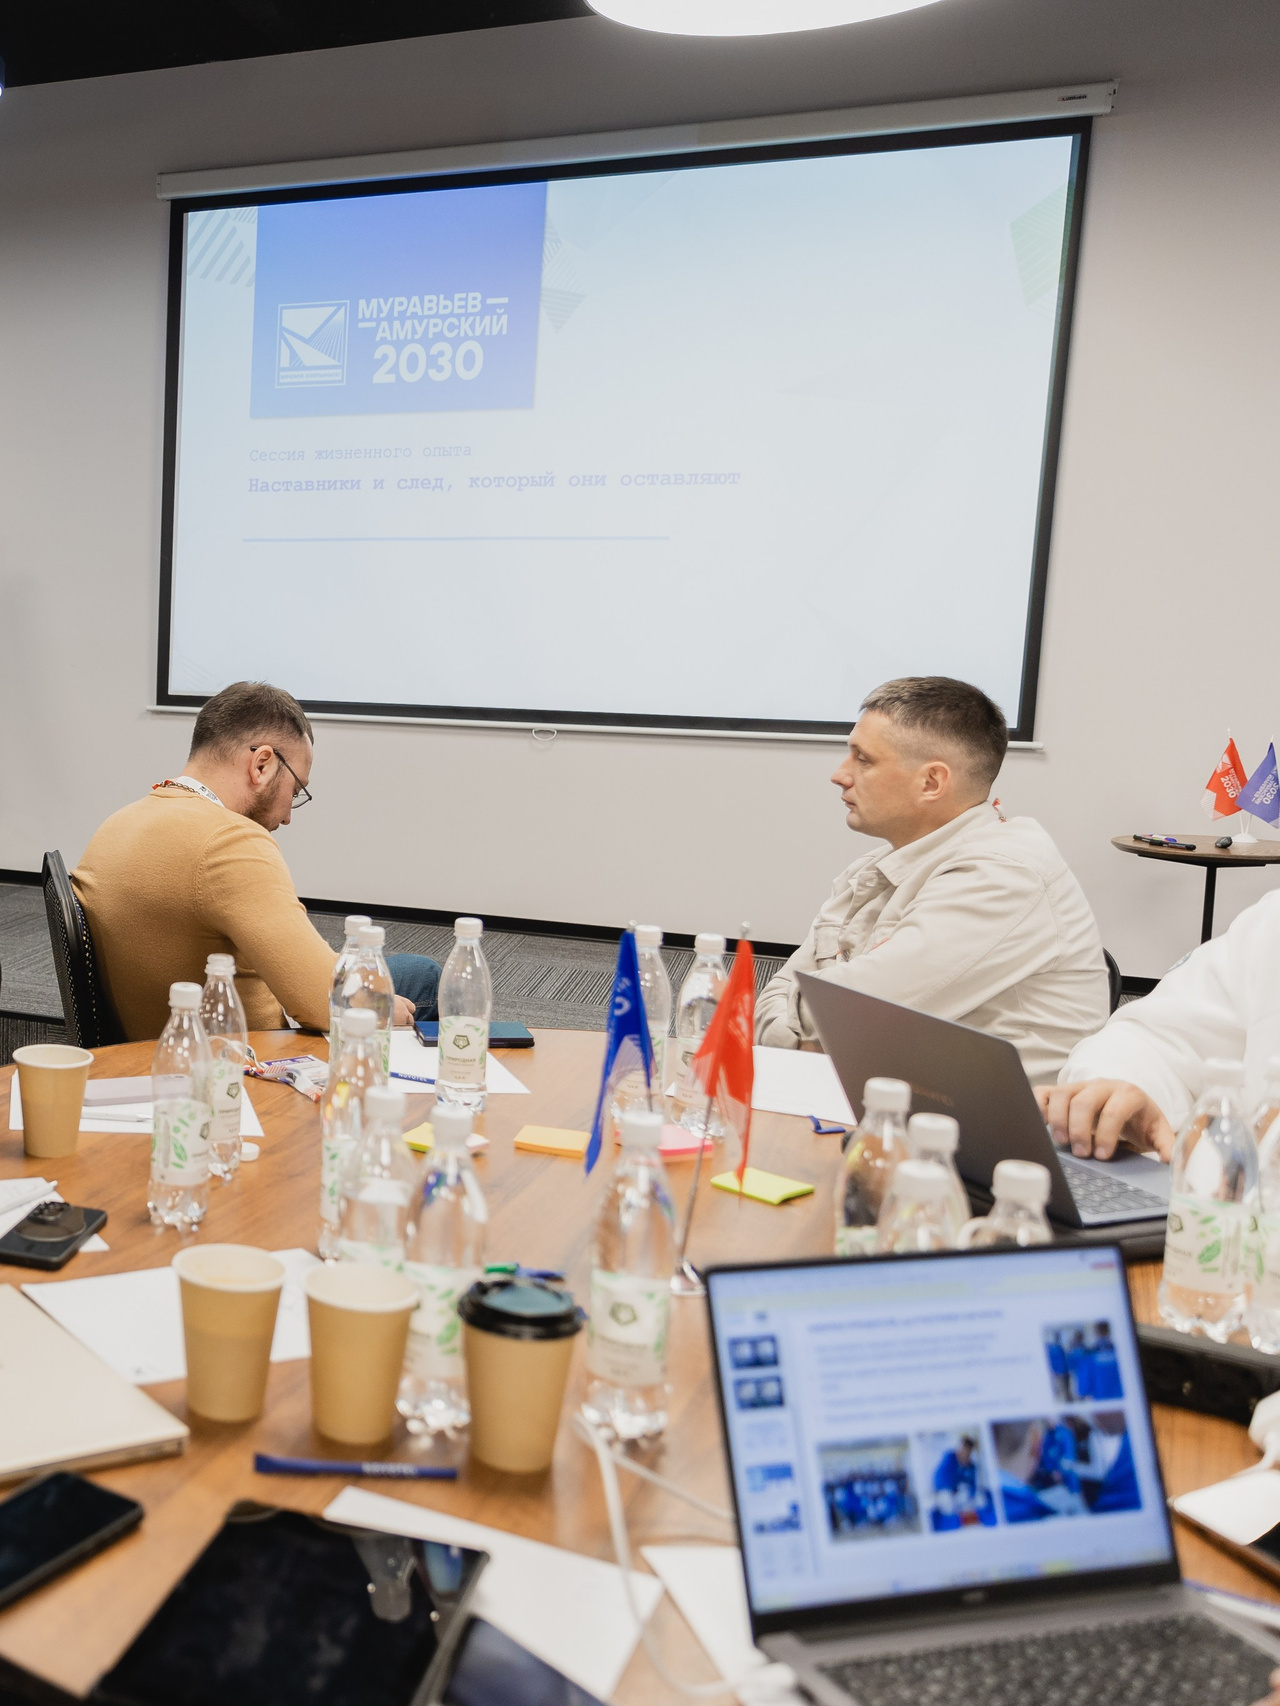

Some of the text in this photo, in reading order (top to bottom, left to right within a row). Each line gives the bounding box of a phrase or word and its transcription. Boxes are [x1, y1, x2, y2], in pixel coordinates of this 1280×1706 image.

[372, 340, 484, 384] 2030
[249, 446, 473, 461] Сессия жизненного опыта
[248, 471, 741, 493] Наставники и след, который они оставляют
[1220, 776, 1237, 798] 2030
